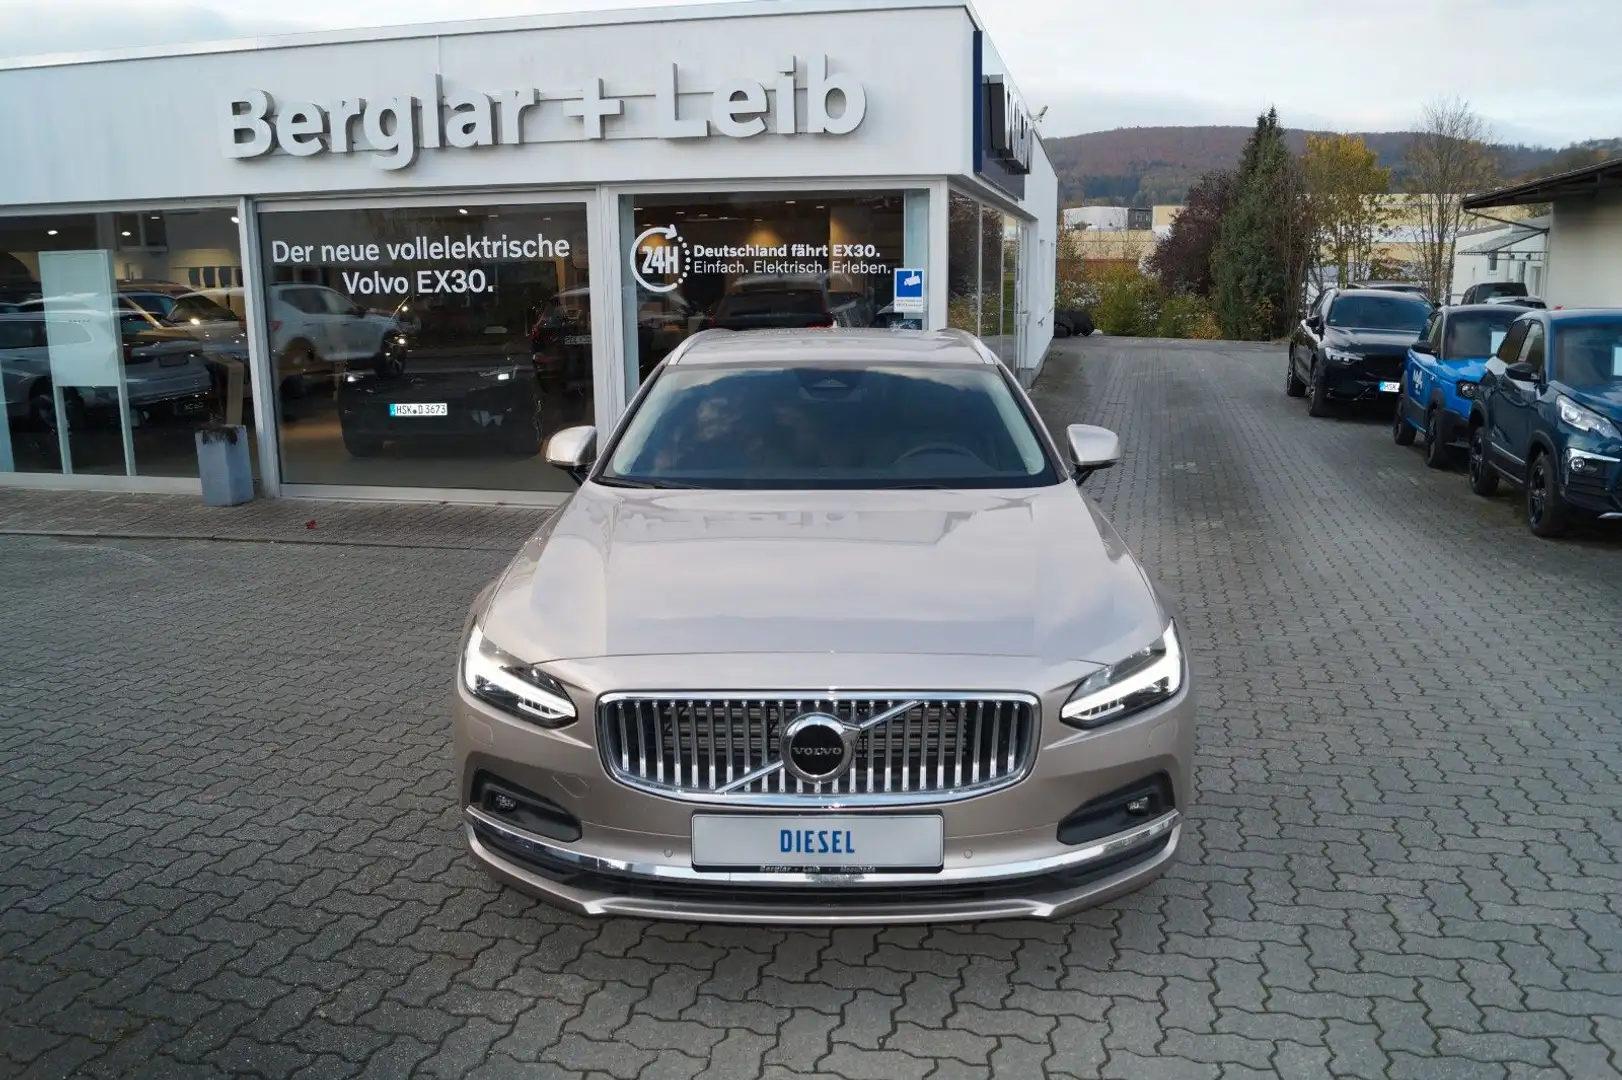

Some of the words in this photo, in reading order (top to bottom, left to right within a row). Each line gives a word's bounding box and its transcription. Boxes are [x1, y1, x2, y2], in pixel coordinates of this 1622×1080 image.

[222, 72, 540, 171] Berglar
[654, 53, 867, 137] Leib
[271, 240, 314, 263] Der
[321, 243, 379, 262] neue
[386, 233, 570, 261] vollelektrische
[641, 246, 679, 274] 24H
[693, 244, 788, 257] Deutschland
[791, 244, 829, 257] fährt
[832, 244, 881, 257] EX30.
[693, 260, 749, 274] Einfach.
[753, 260, 827, 274] Elektrisch.
[832, 260, 891, 274] Erleben.
[342, 270, 409, 295] Volvo
[417, 268, 494, 294] EX30.
[791, 746, 842, 756] VOLVO
[780, 829, 855, 853] DIESEL
